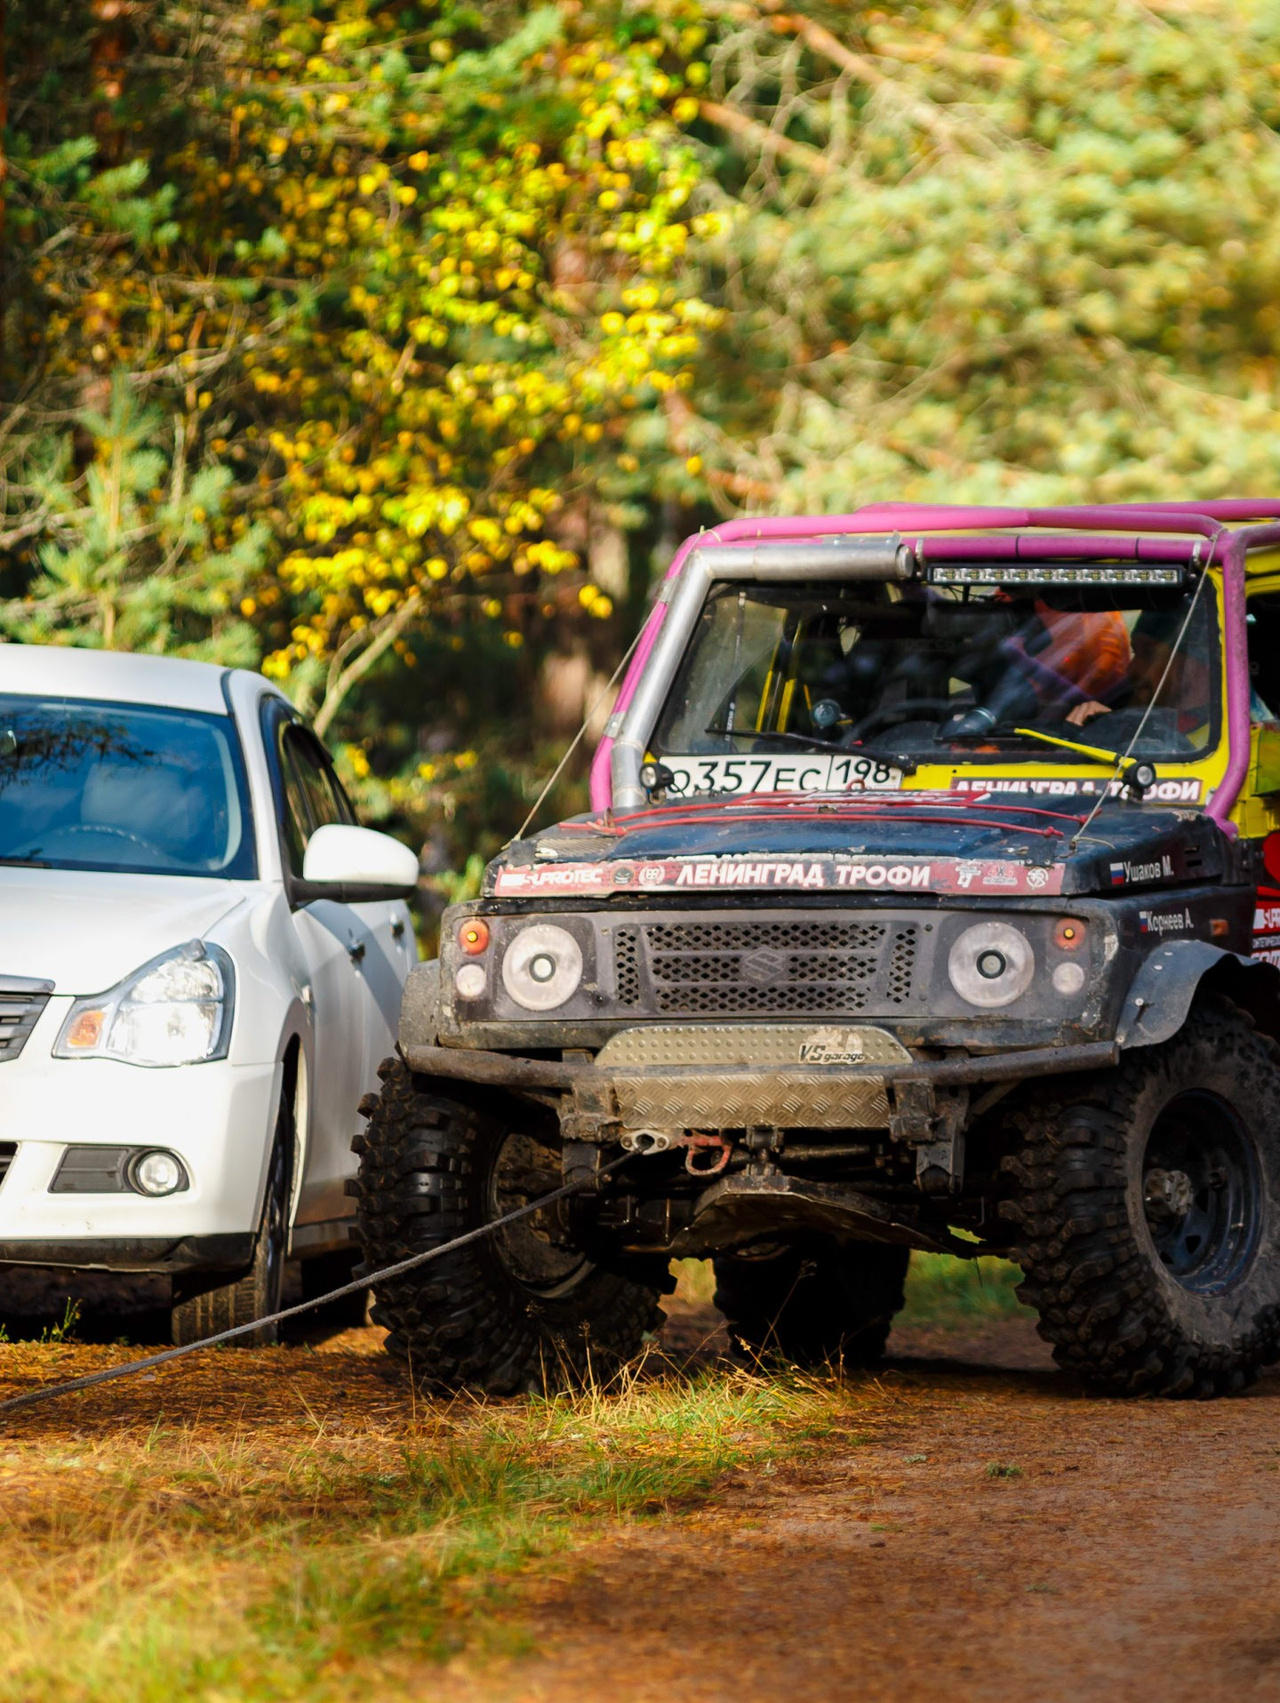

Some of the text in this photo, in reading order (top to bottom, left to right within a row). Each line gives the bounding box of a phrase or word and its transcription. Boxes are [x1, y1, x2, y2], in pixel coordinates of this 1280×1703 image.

[835, 759, 890, 784] 198
[500, 869, 603, 887] SUPROTEC
[675, 863, 825, 887] ЛЕНИНГРАД
[836, 865, 931, 887] ТРОФИ
[1124, 855, 1174, 883] Ушаков М.
[1146, 908, 1194, 937] Корнеев А.
[799, 1044, 864, 1062] VS garage
